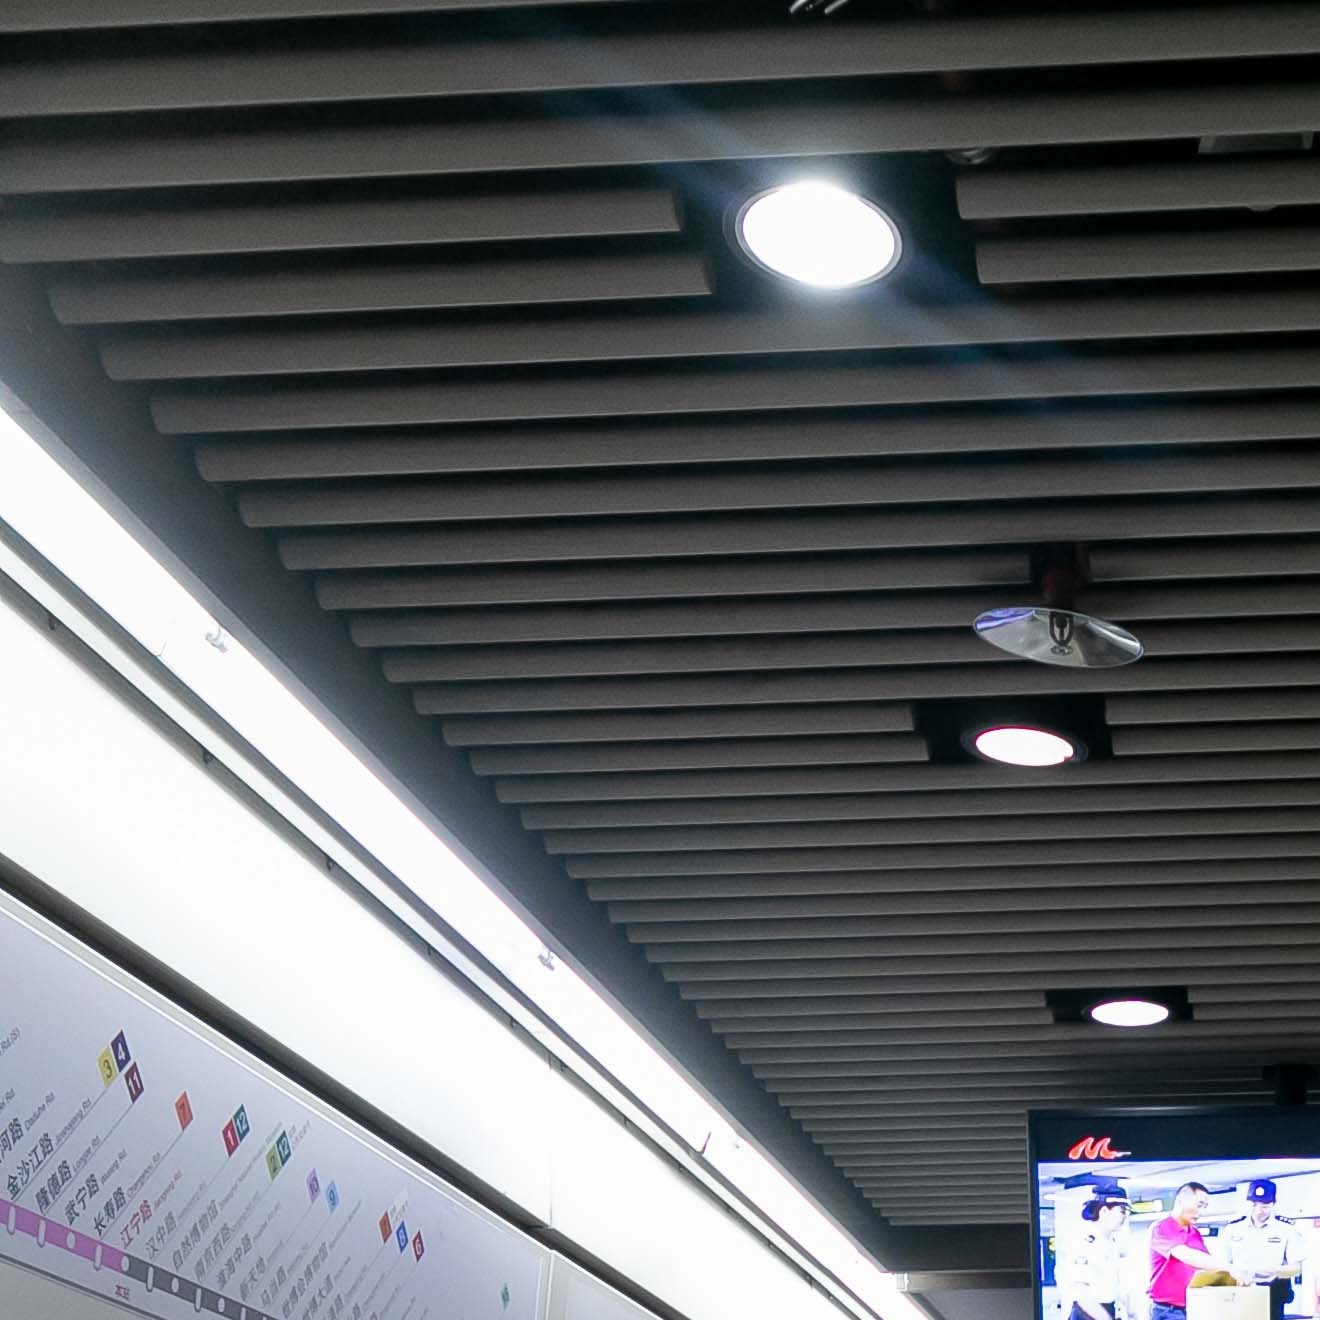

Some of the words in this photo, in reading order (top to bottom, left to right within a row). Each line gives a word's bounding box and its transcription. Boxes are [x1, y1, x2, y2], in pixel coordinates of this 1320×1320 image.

[6, 1133, 54, 1200] 金沙江路
[64, 1173, 100, 1226] 武宁路
[93, 1186, 128, 1236] 长寿路
[120, 1200, 153, 1250] 江宁路
